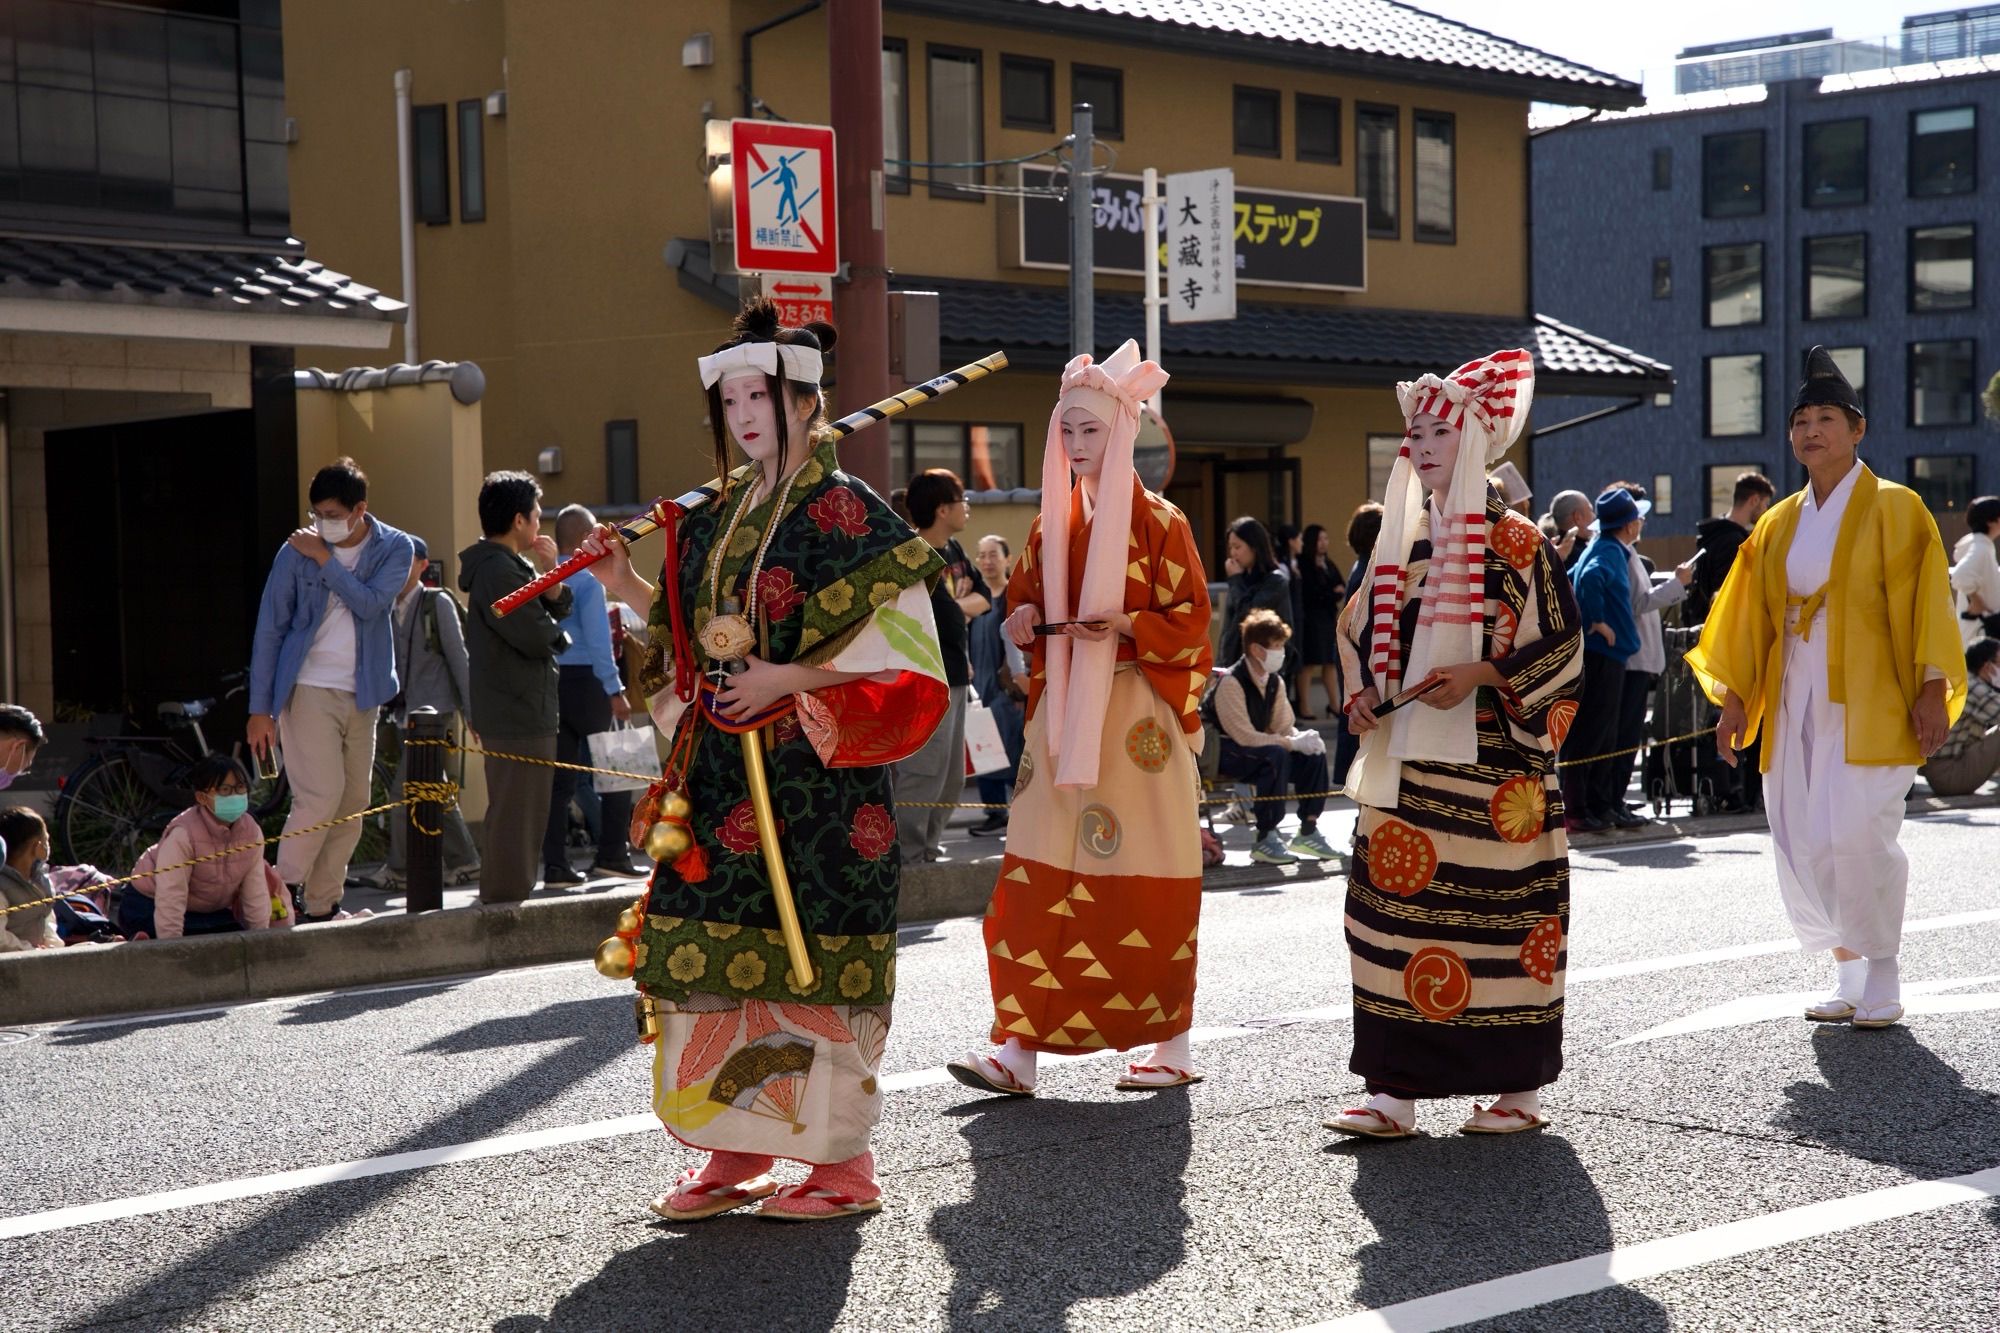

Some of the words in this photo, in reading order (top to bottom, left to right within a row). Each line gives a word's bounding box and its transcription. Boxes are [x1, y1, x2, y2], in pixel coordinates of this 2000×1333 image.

[756, 227, 804, 248] 横断禁止
[1233, 203, 1322, 247] ステップ
